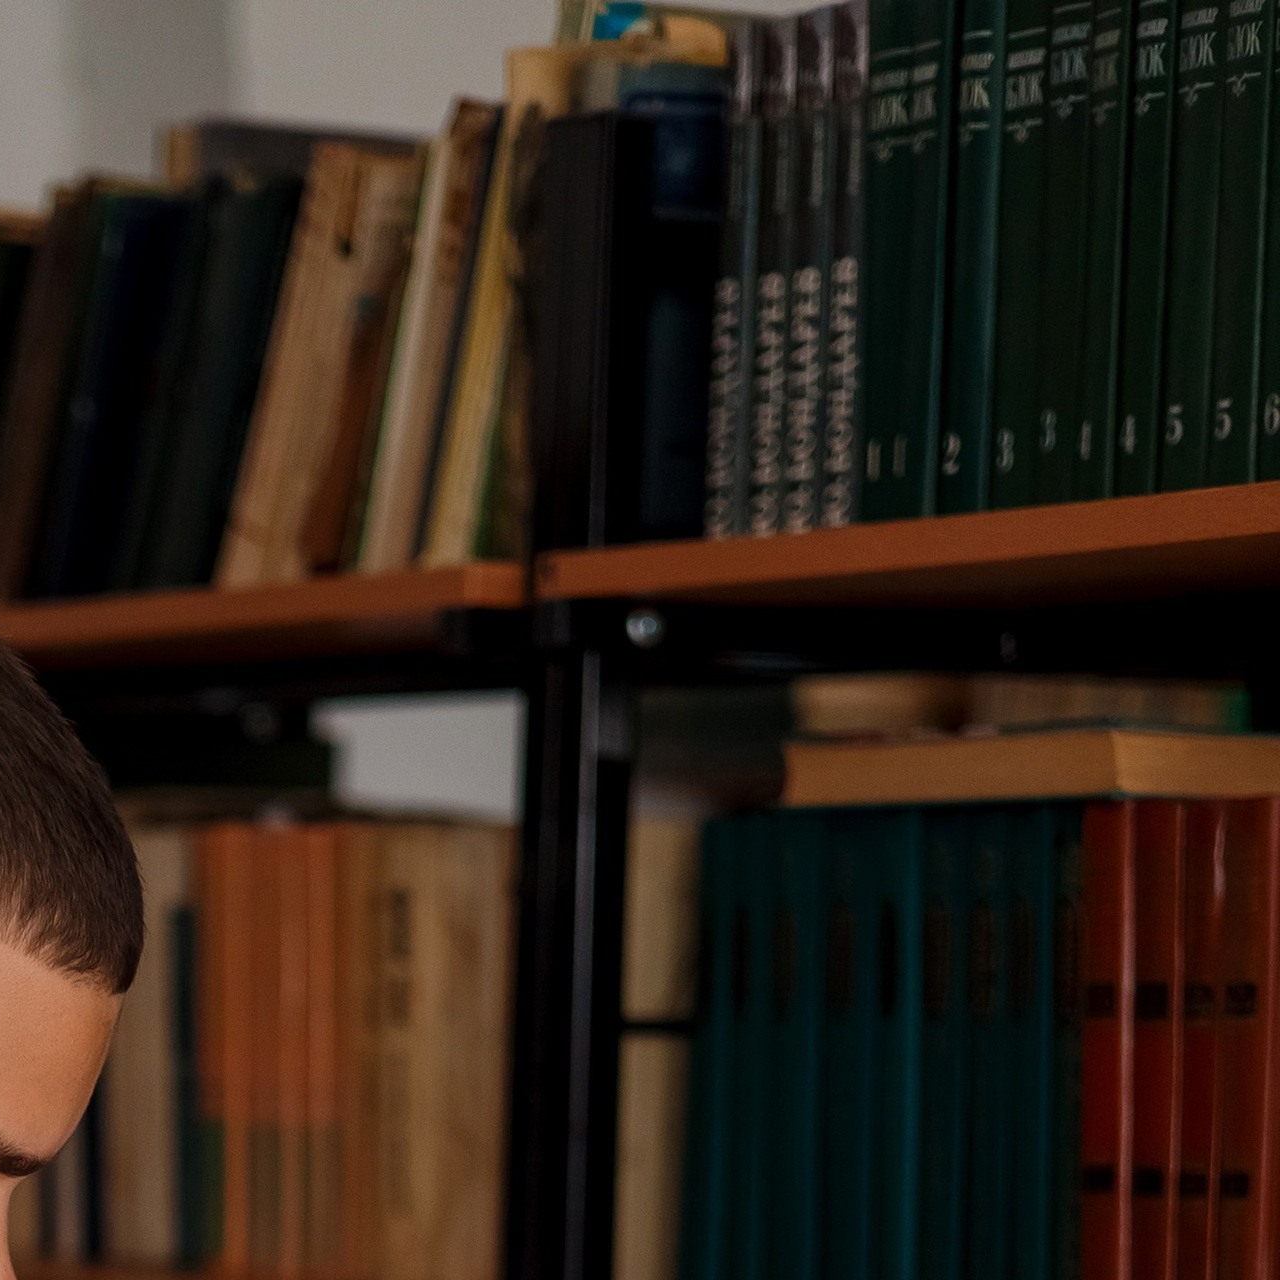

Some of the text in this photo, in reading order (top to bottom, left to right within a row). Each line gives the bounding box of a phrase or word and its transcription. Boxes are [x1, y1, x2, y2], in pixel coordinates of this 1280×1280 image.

[1038, 406, 1058, 455] 3
[1165, 402, 1185, 447] 5
[1214, 394, 1235, 441] 5
[1263, 391, 1280, 437] 6
[941, 430, 962, 477] 2
[996, 426, 1015, 474] 3
